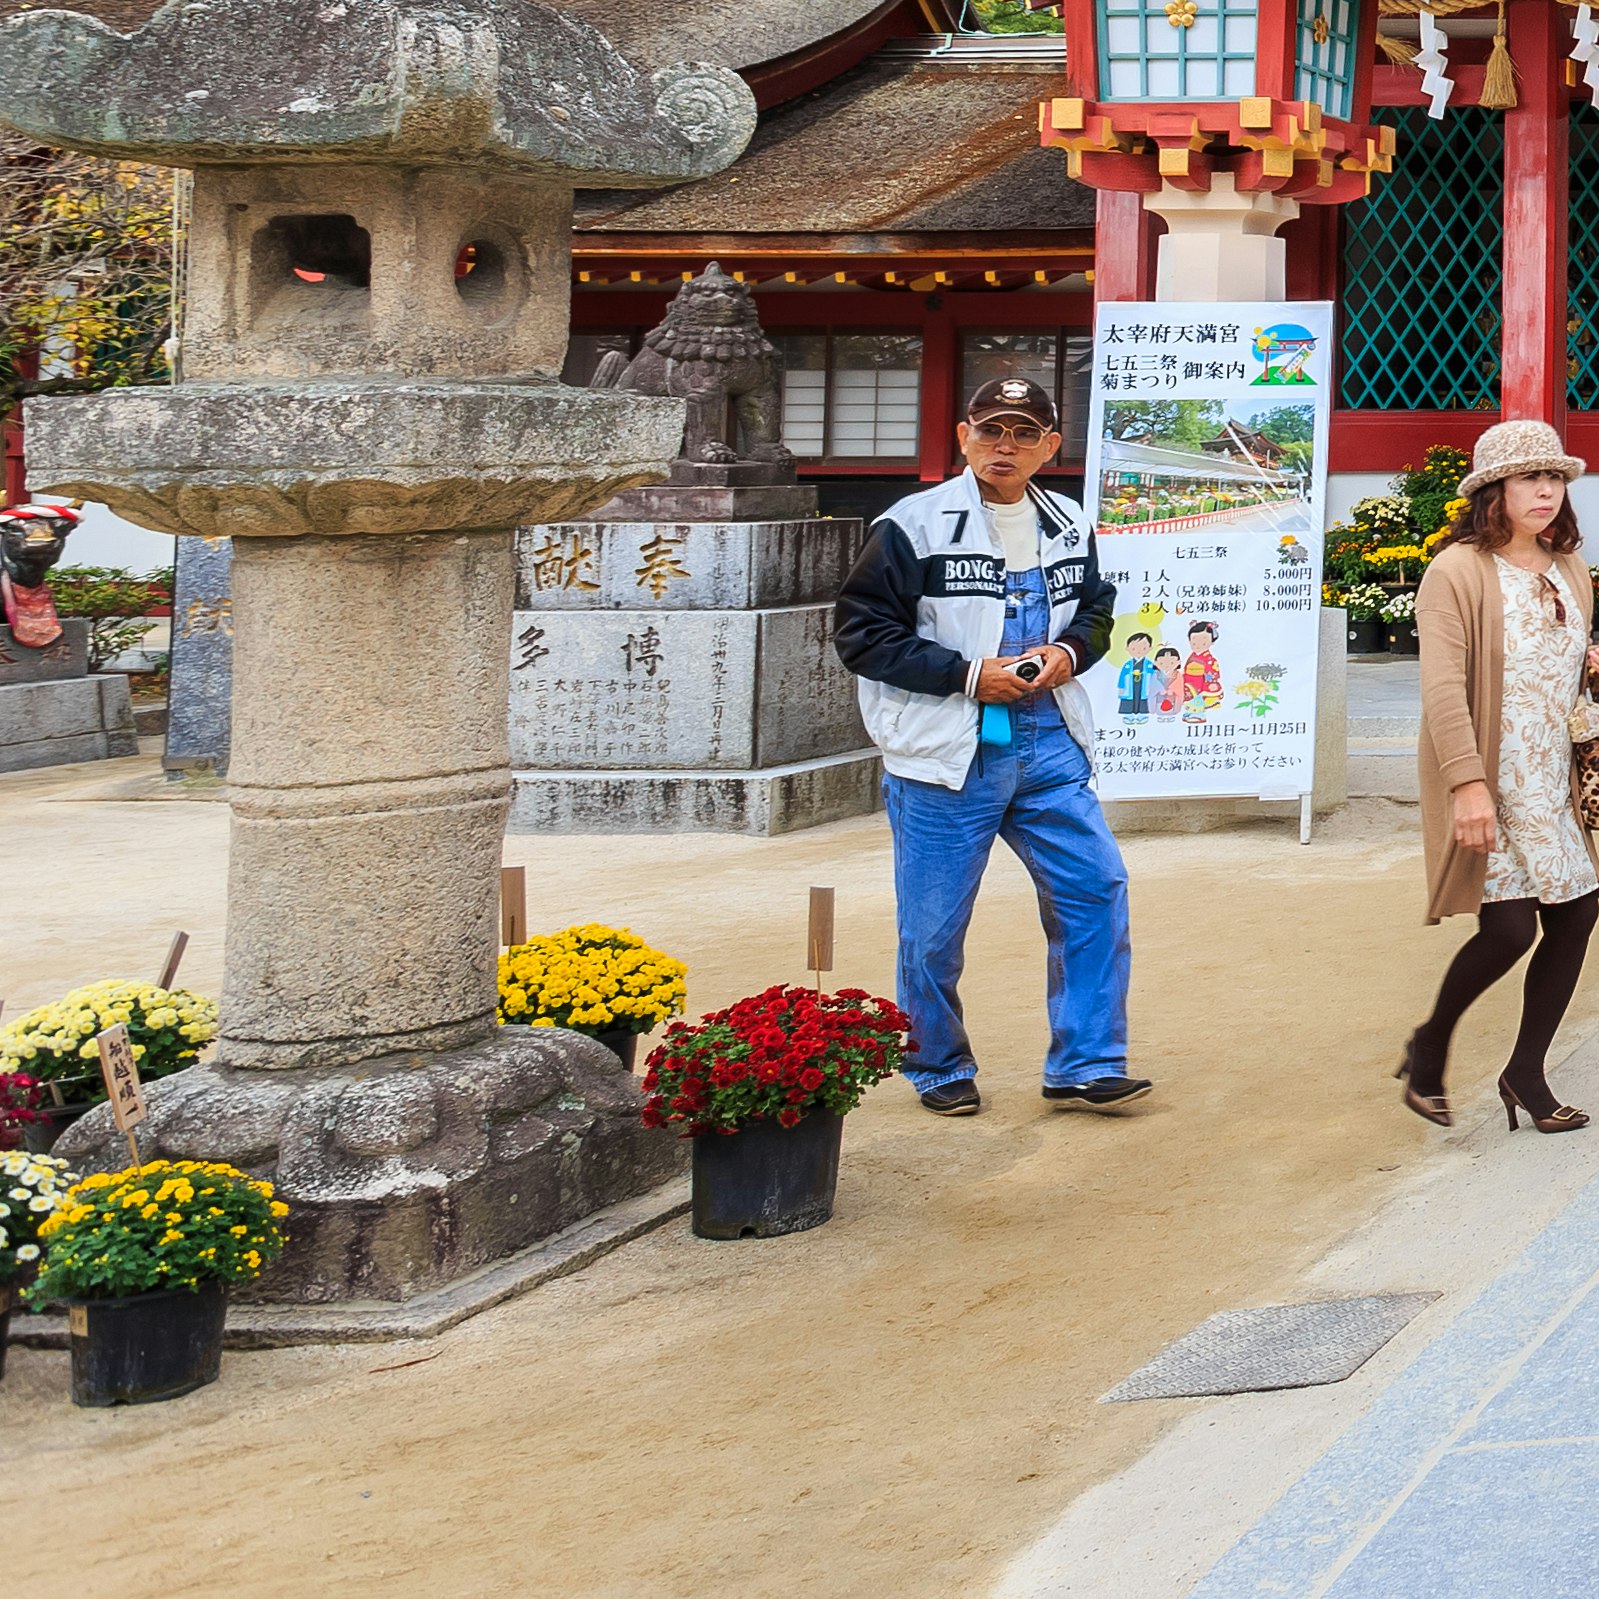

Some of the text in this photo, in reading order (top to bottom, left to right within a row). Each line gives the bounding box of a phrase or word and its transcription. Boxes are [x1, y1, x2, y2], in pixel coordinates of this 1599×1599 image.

[1102, 324, 1240, 344] 太宰府天満宮
[1100, 353, 1178, 371] 七五三祭
[1182, 360, 1246, 380] 御案内
[1100, 373, 1178, 390] 菊まつり
[942, 509, 970, 546] 7
[1172, 546, 1228, 559] 七五三祭
[1256, 598, 1311, 612] 10,000円
